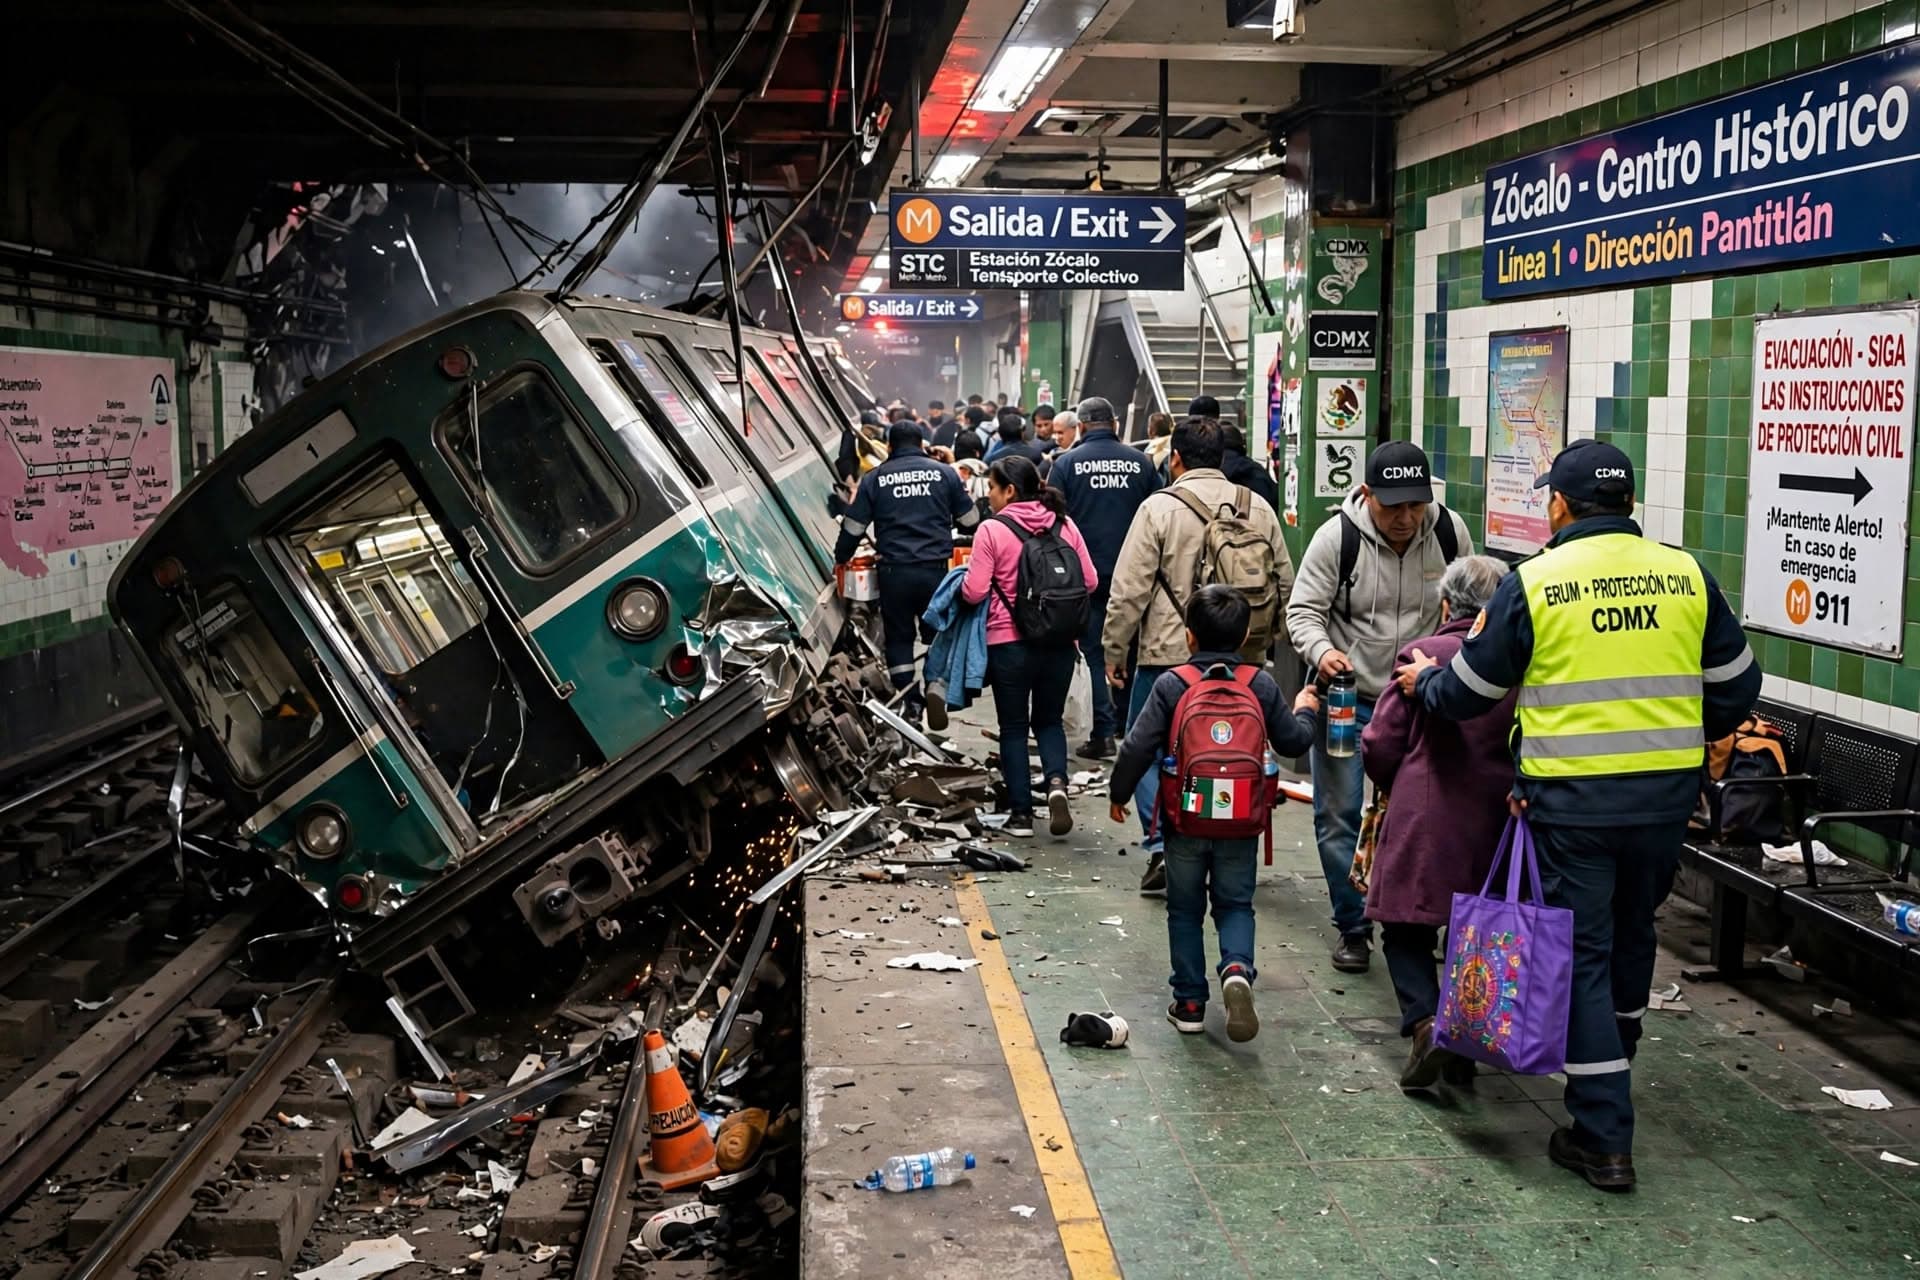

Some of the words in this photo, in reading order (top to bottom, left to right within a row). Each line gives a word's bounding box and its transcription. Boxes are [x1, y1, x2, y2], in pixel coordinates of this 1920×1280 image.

[1490, 161, 1571, 227] Zócalo
[1597, 135, 1702, 204] Centro
[1713, 79, 1909, 179] Histórico
[949, 205, 1044, 237] Salida
[1050, 206, 1063, 237] /
[1071, 206, 1129, 237] Exit
[1326, 239, 1370, 254] CDMX
[1498, 246, 1547, 284] Línea
[1551, 239, 1562, 276] 1
[1584, 216, 1694, 272] Dirección
[1701, 192, 1834, 256] Pantitlán
[900, 253, 945, 273] STC
[970, 252, 1040, 267] Estación
[1045, 252, 1100, 267] Zócalo
[1062, 269, 1139, 284] Colectivo
[868, 300, 914, 316] Salida
[926, 300, 956, 316] Exit
[1314, 330, 1370, 347] CDMX
[1764, 329, 1853, 369] EVACUACIÓN
[1868, 334, 1906, 368] SIGA
[1761, 381, 1785, 411] LAS
[1789, 379, 1905, 412] INSTRUCCIONES
[1757, 422, 1774, 451] DE
[1777, 416, 1862, 457] PROTECCIÓN
[1866, 424, 1904, 459] CIVIL
[306, 442, 321, 459] 1
[878, 468, 942, 488] BOMBEROS
[1074, 460, 1141, 476] BOMBEROS
[1382, 464, 1424, 480] CDMX
[1595, 467, 1628, 480] CDMX
[893, 482, 932, 499] CDMX
[1090, 473, 1129, 489] CDMX
[1767, 506, 1831, 534] ¡Mantente
[1785, 534, 1802, 554] En
[1805, 540, 1836, 559] caso
[1839, 541, 1857, 562] de
[1781, 558, 1857, 584] emergencia
[1544, 580, 1581, 607] ERUM
[1593, 569, 1665, 599] PROTECCIÓN
[1667, 574, 1696, 598] CIVIL
[1591, 604, 1660, 633] CDMX
[1815, 592, 1850, 626] 911
